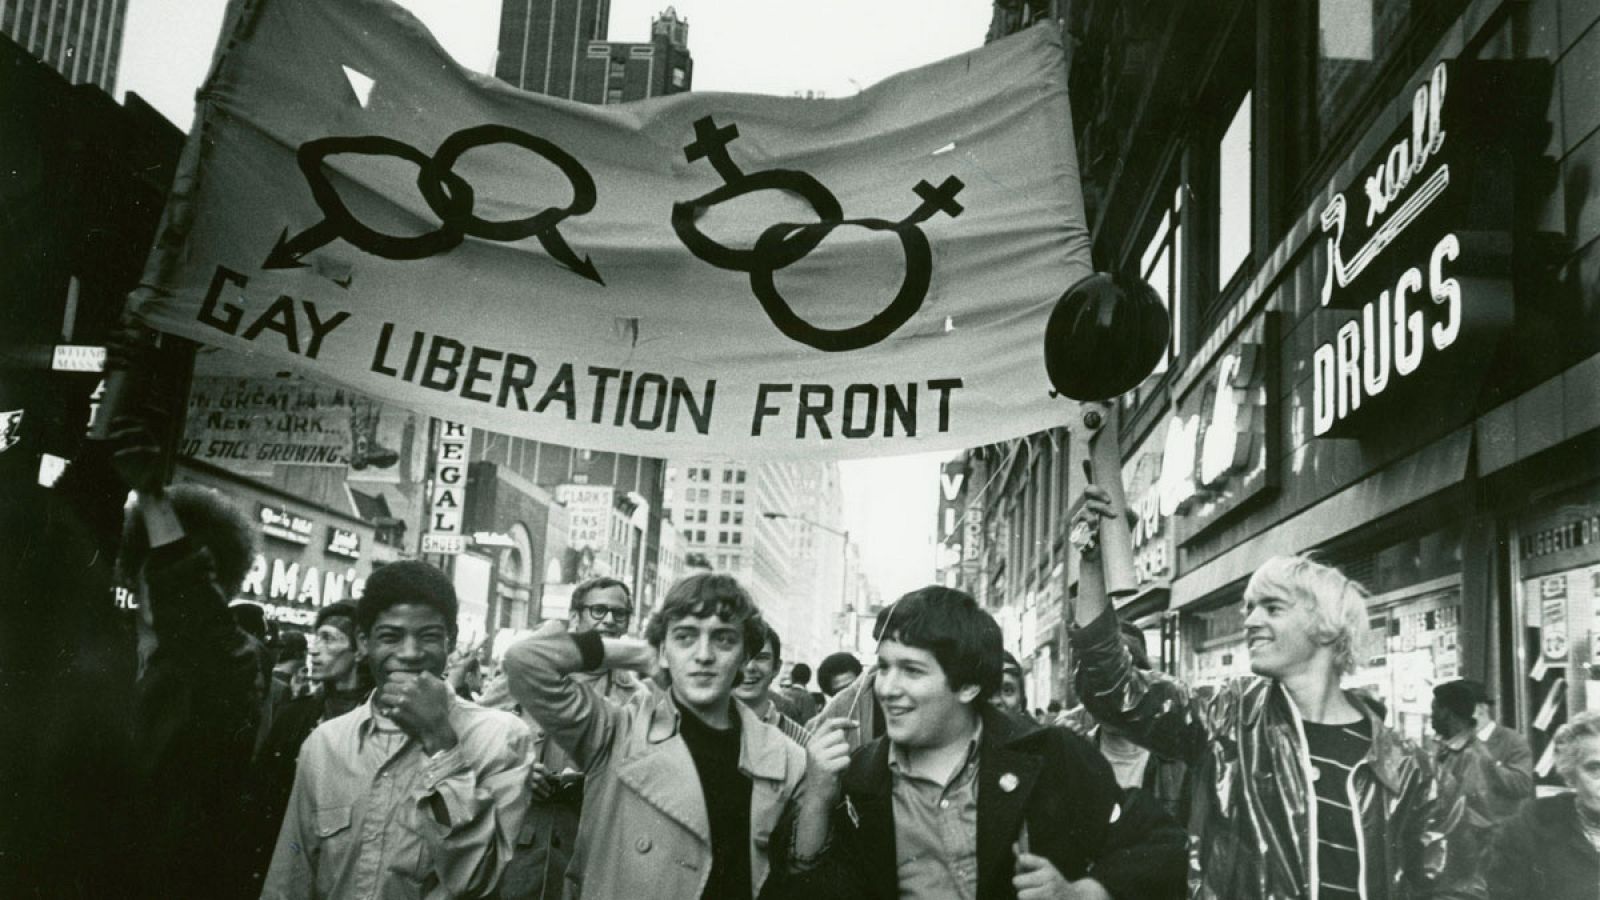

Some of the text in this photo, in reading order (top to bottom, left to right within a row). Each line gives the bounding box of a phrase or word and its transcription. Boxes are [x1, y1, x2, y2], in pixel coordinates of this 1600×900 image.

[196, 264, 964, 440] GAY LIBERATION FRONT
[1312, 233, 1461, 437] DRUGS
[205, 440, 249, 460] STILL
[433, 420, 465, 532] REGAL
[424, 537, 461, 551] SHOES
